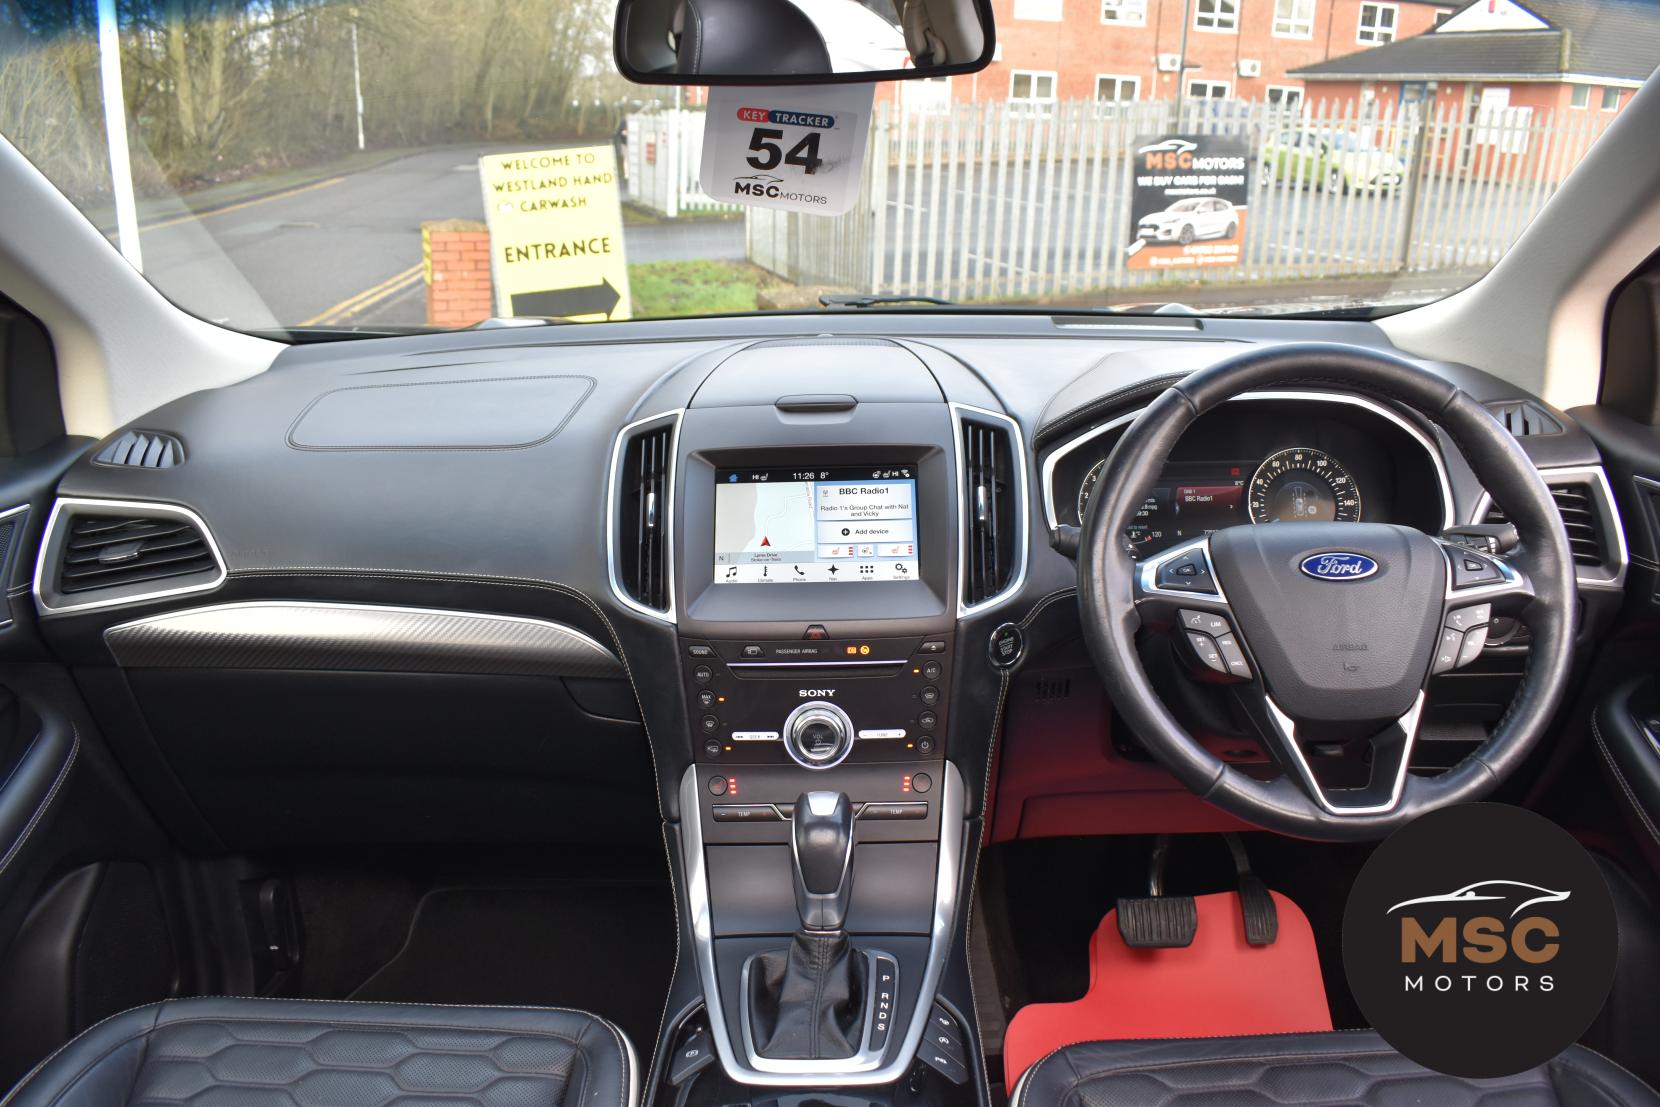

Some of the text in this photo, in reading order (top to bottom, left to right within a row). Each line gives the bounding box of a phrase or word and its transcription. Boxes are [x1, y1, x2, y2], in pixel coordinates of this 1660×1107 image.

[743, 110, 829, 126] KEY TRACKER
[746, 127, 823, 175] 54
[502, 153, 595, 170] WELCOME TO
[1146, 151, 1245, 170] MSC MOTORS
[493, 173, 613, 192] WESTLAND HAND
[1137, 176, 1152, 186] WE
[1153, 176, 1173, 186] BUY
[734, 181, 827, 205] MSC MOTORS
[520, 197, 587, 212] CARWASH
[505, 237, 611, 263] ENTRANCE
[793, 472, 815, 480] 11:26
[1317, 556, 1363, 575] Ford
[799, 689, 835, 697] SONY
